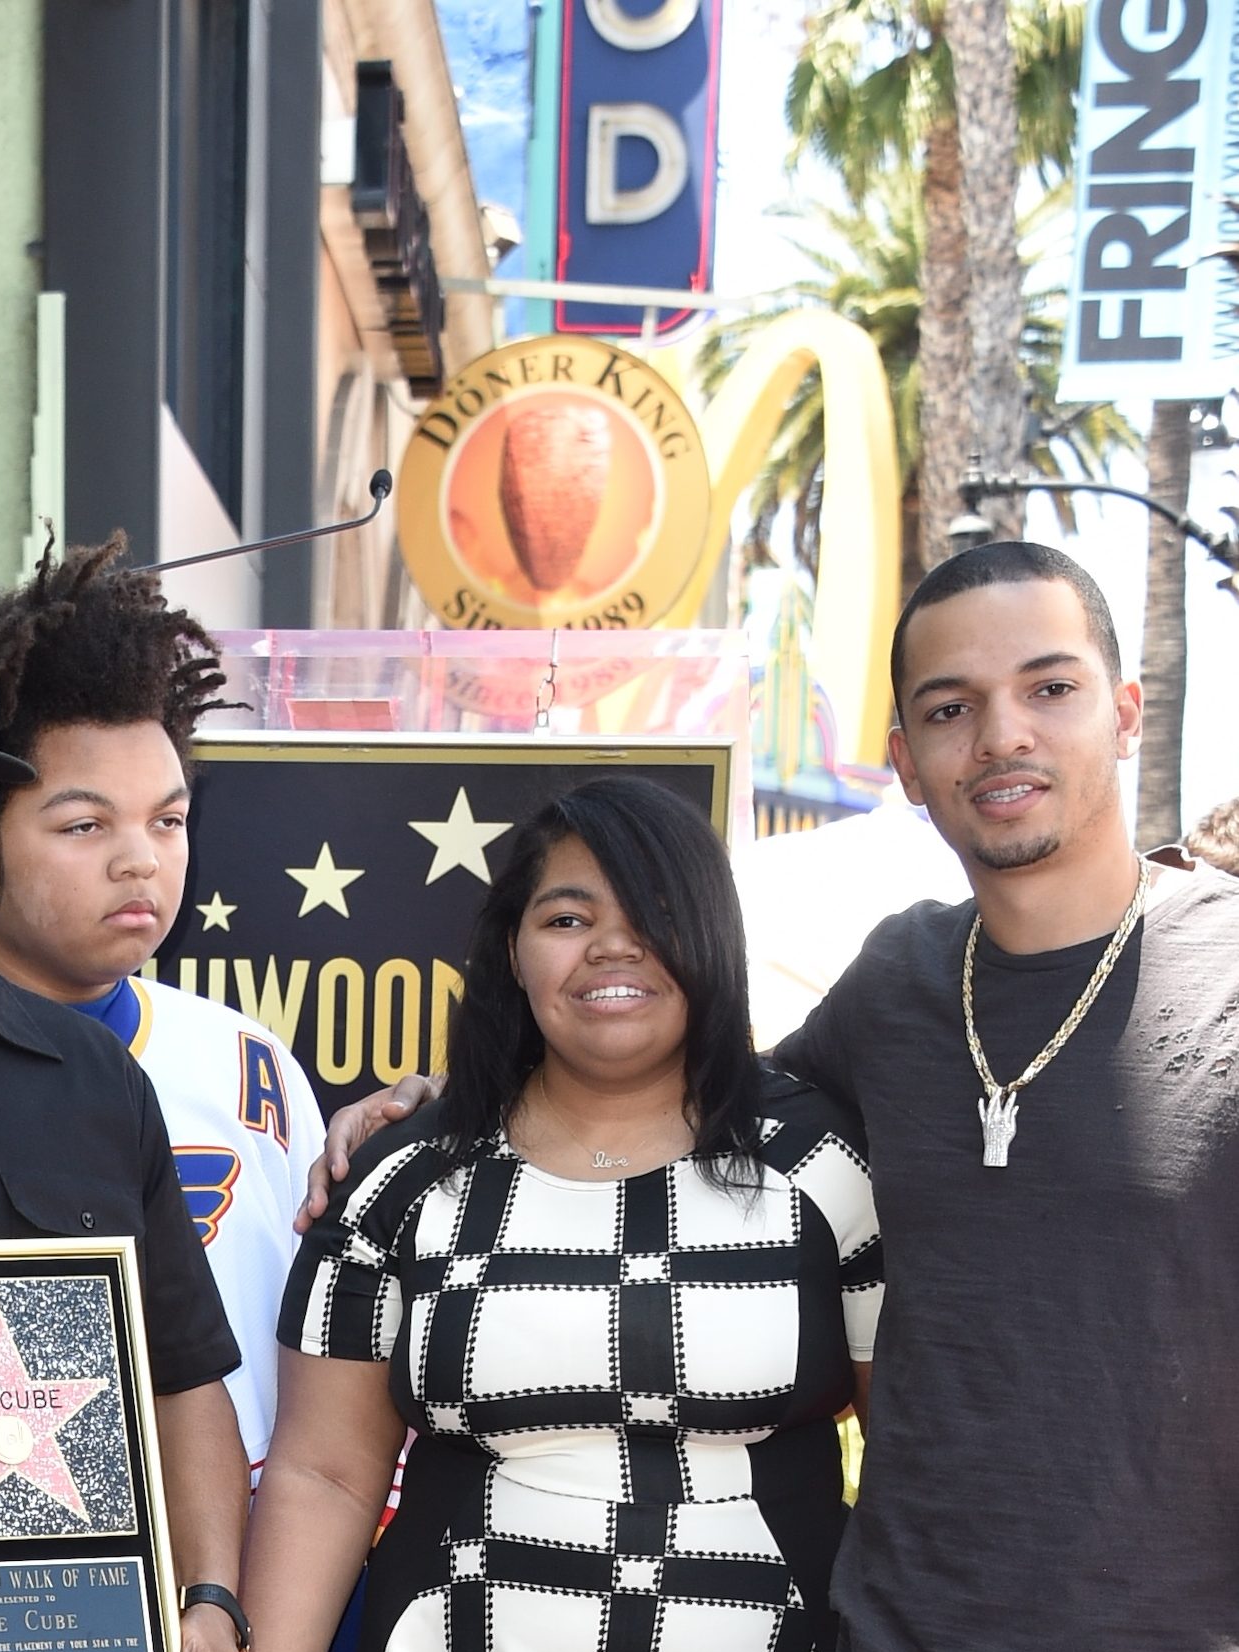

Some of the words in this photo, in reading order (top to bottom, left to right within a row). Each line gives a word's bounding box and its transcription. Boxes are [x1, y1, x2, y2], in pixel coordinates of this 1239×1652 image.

[1077, 0, 1208, 363] FRING
[417, 353, 575, 451] DÖNER
[595, 349, 692, 461] KING
[238, 1030, 291, 1152] A
[0, 1389, 62, 1410] CUBE
[9, 1569, 53, 1590] WALK
[62, 1568, 79, 1588] OF
[89, 1566, 129, 1586] FAME
[24, 1610, 78, 1631] CUBE
[14, 1641, 53, 1651] PLACEMENT
[70, 1639, 88, 1649] YOUR
[92, 1639, 109, 1648] STAR
[113, 1638, 122, 1647] IN
[125, 1637, 138, 1647] THE
